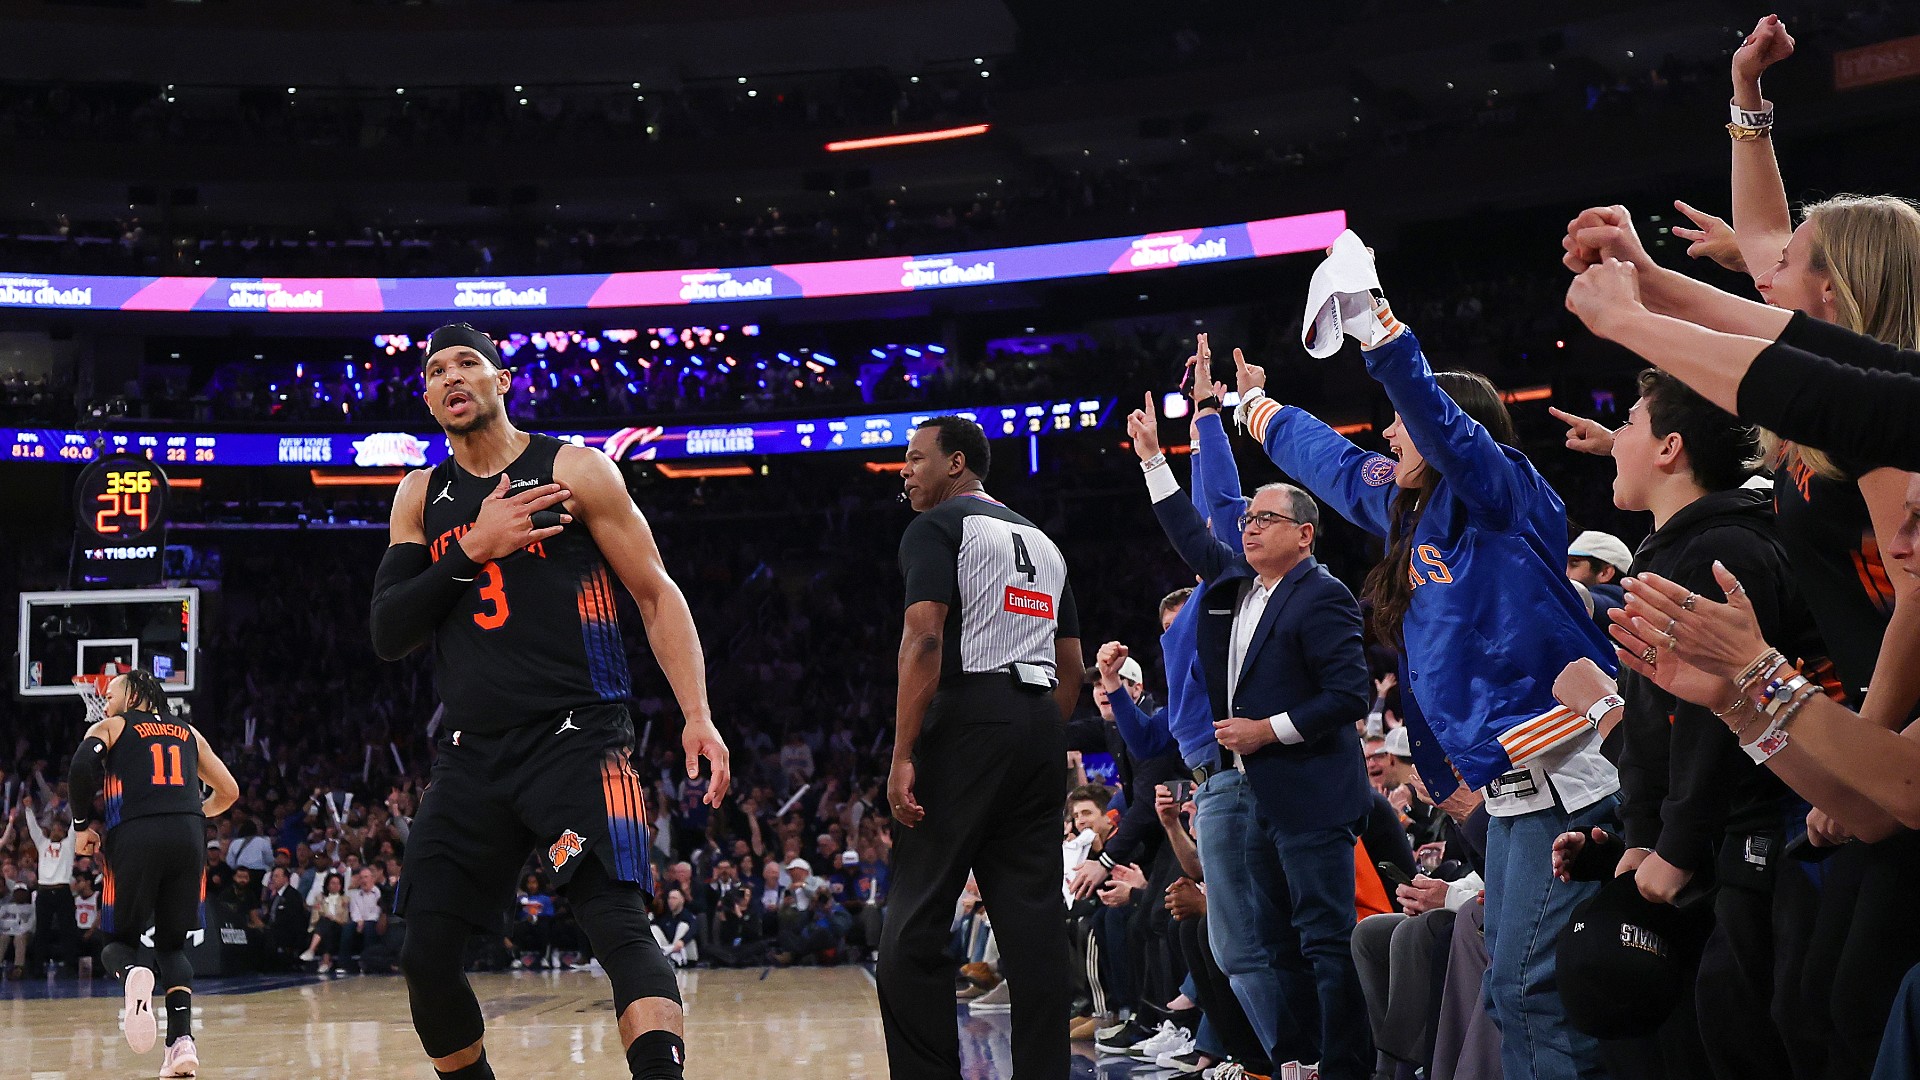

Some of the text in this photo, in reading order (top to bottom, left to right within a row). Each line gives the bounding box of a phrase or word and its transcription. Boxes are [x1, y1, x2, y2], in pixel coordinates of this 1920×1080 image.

[1170, 238, 1226, 262] dhabi
[940, 262, 995, 284] dhabi
[35, 286, 91, 305] dhabi
[492, 287, 547, 306] dhabi
[718, 277, 772, 298] dhabi
[267, 290, 323, 308] dhabi
[279, 437, 332, 447] NEW YORK
[686, 438, 754, 454] CAVALIERS
[60, 446, 93, 459] 40.0
[167, 448, 187, 461] 22
[195, 448, 215, 461] 26
[278, 445, 332, 462] KNICKS
[106, 471, 152, 494] 3:56
[96, 493, 149, 533] 24
[104, 546, 157, 560] TISSOT
[1011, 532, 1037, 583] 4
[473, 560, 511, 630] 3
[1008, 592, 1050, 613] Emirates
[133, 722, 190, 742] BRUNSON
[149, 743, 185, 787] 11
